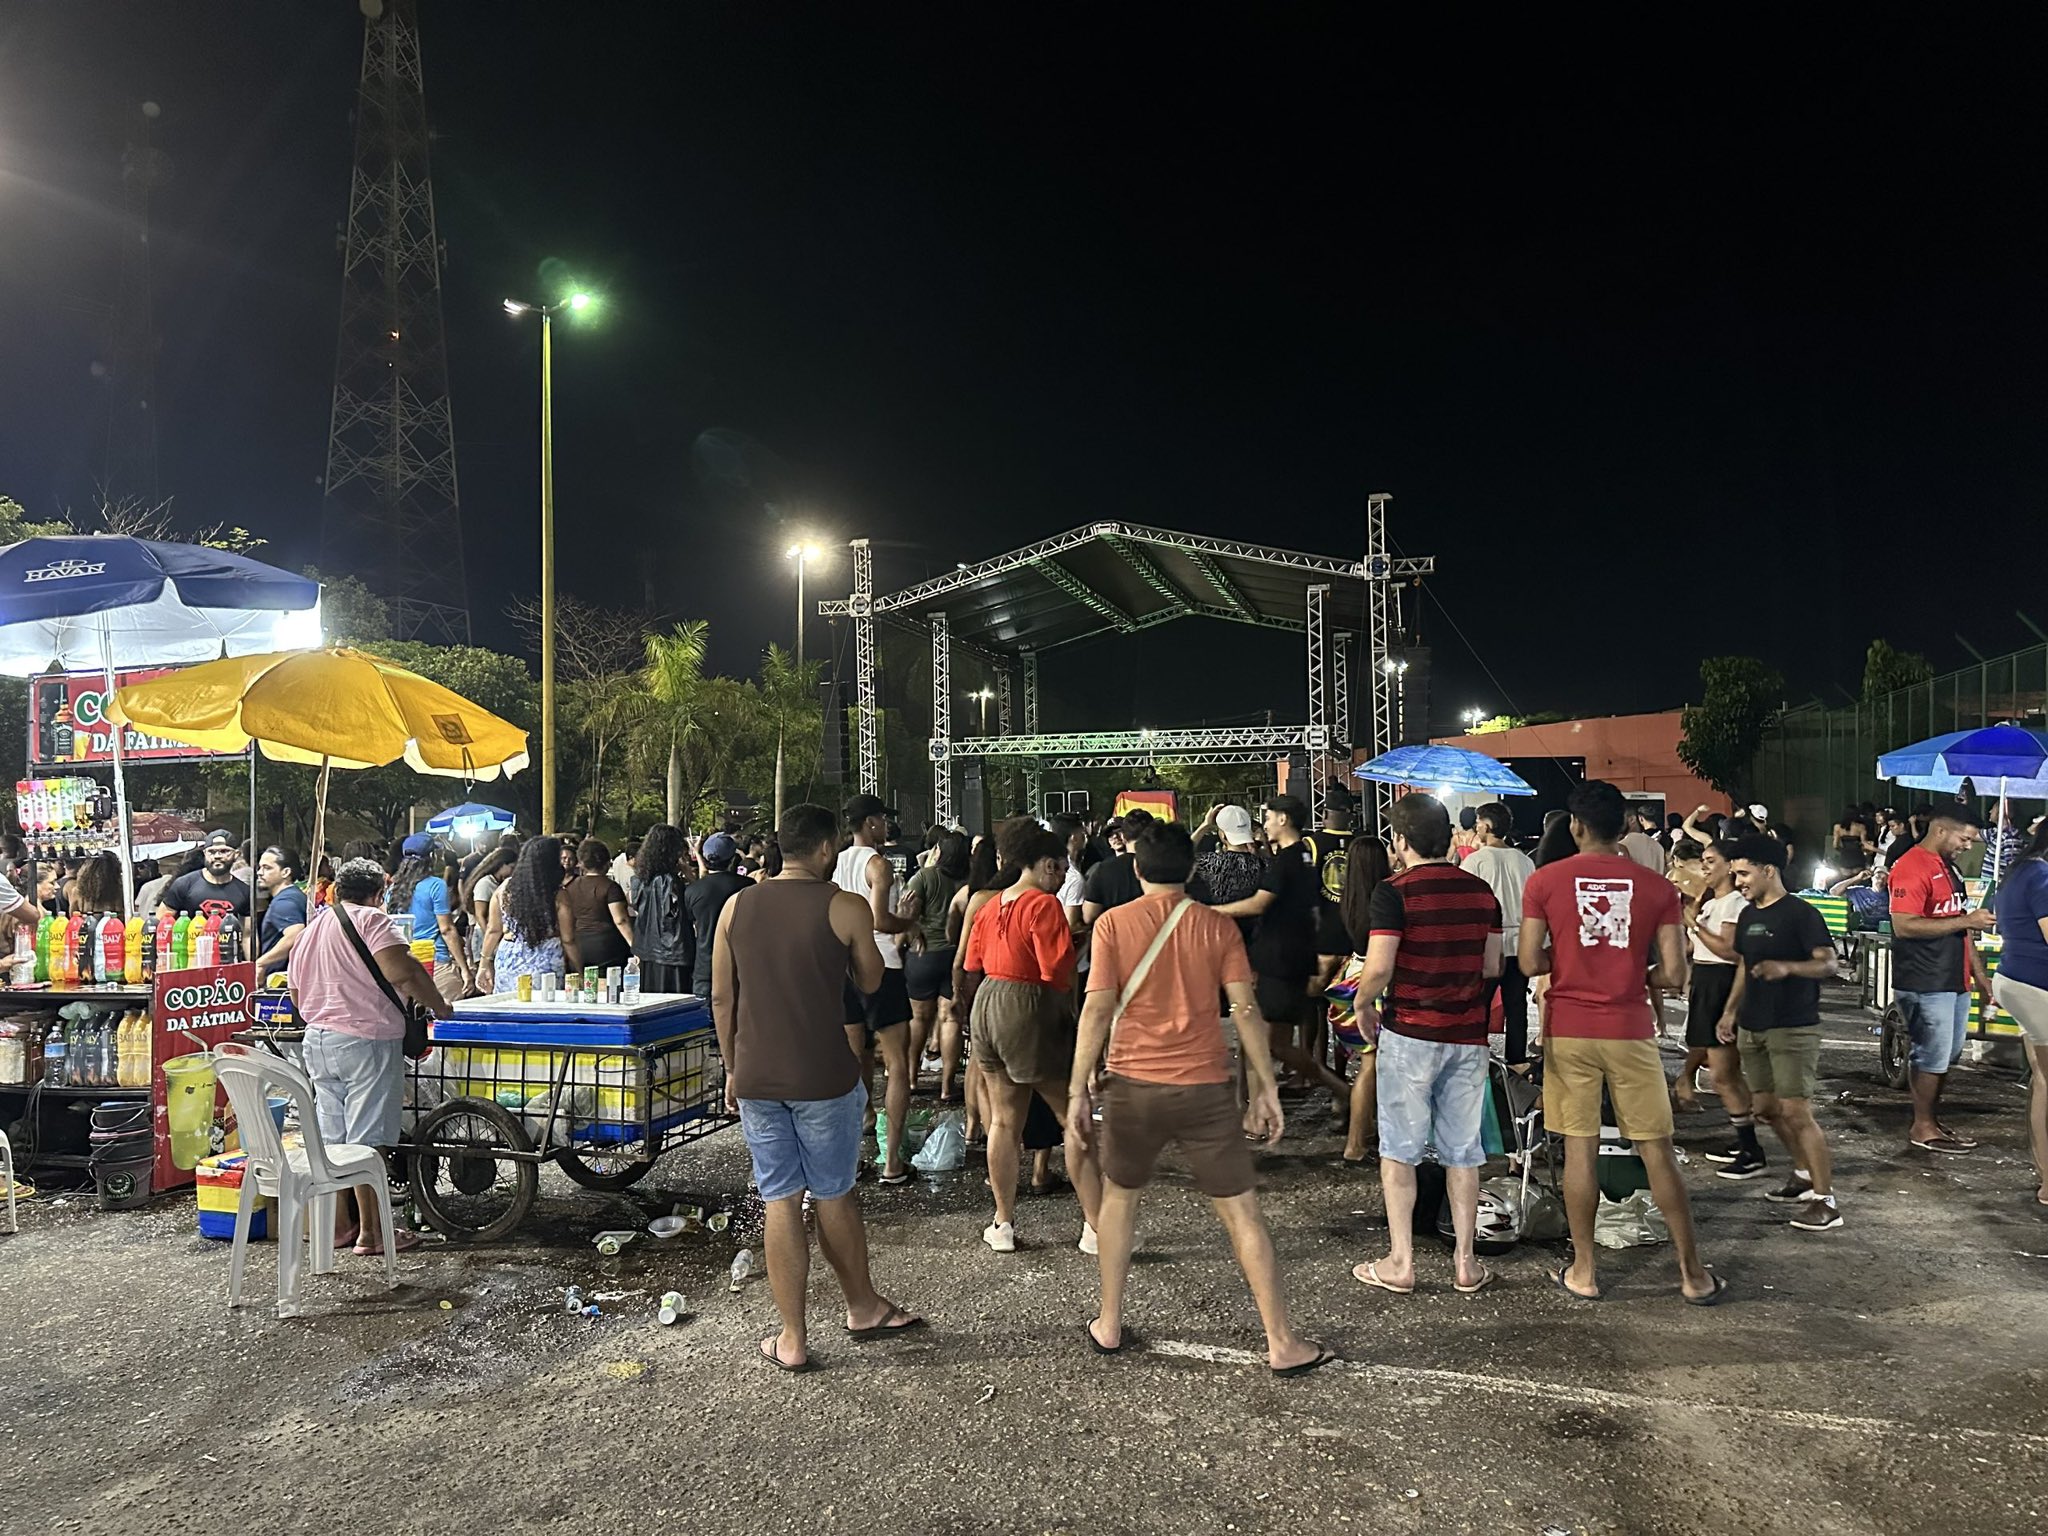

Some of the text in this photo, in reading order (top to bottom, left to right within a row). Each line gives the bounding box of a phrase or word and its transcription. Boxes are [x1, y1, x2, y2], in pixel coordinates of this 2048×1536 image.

[27, 564, 105, 580] HAVAN
[102, 933, 121, 944] BALY
[165, 979, 245, 1010] COPÃO
[166, 1018, 189, 1031] DA
[191, 1010, 246, 1029] FÁTIMA
